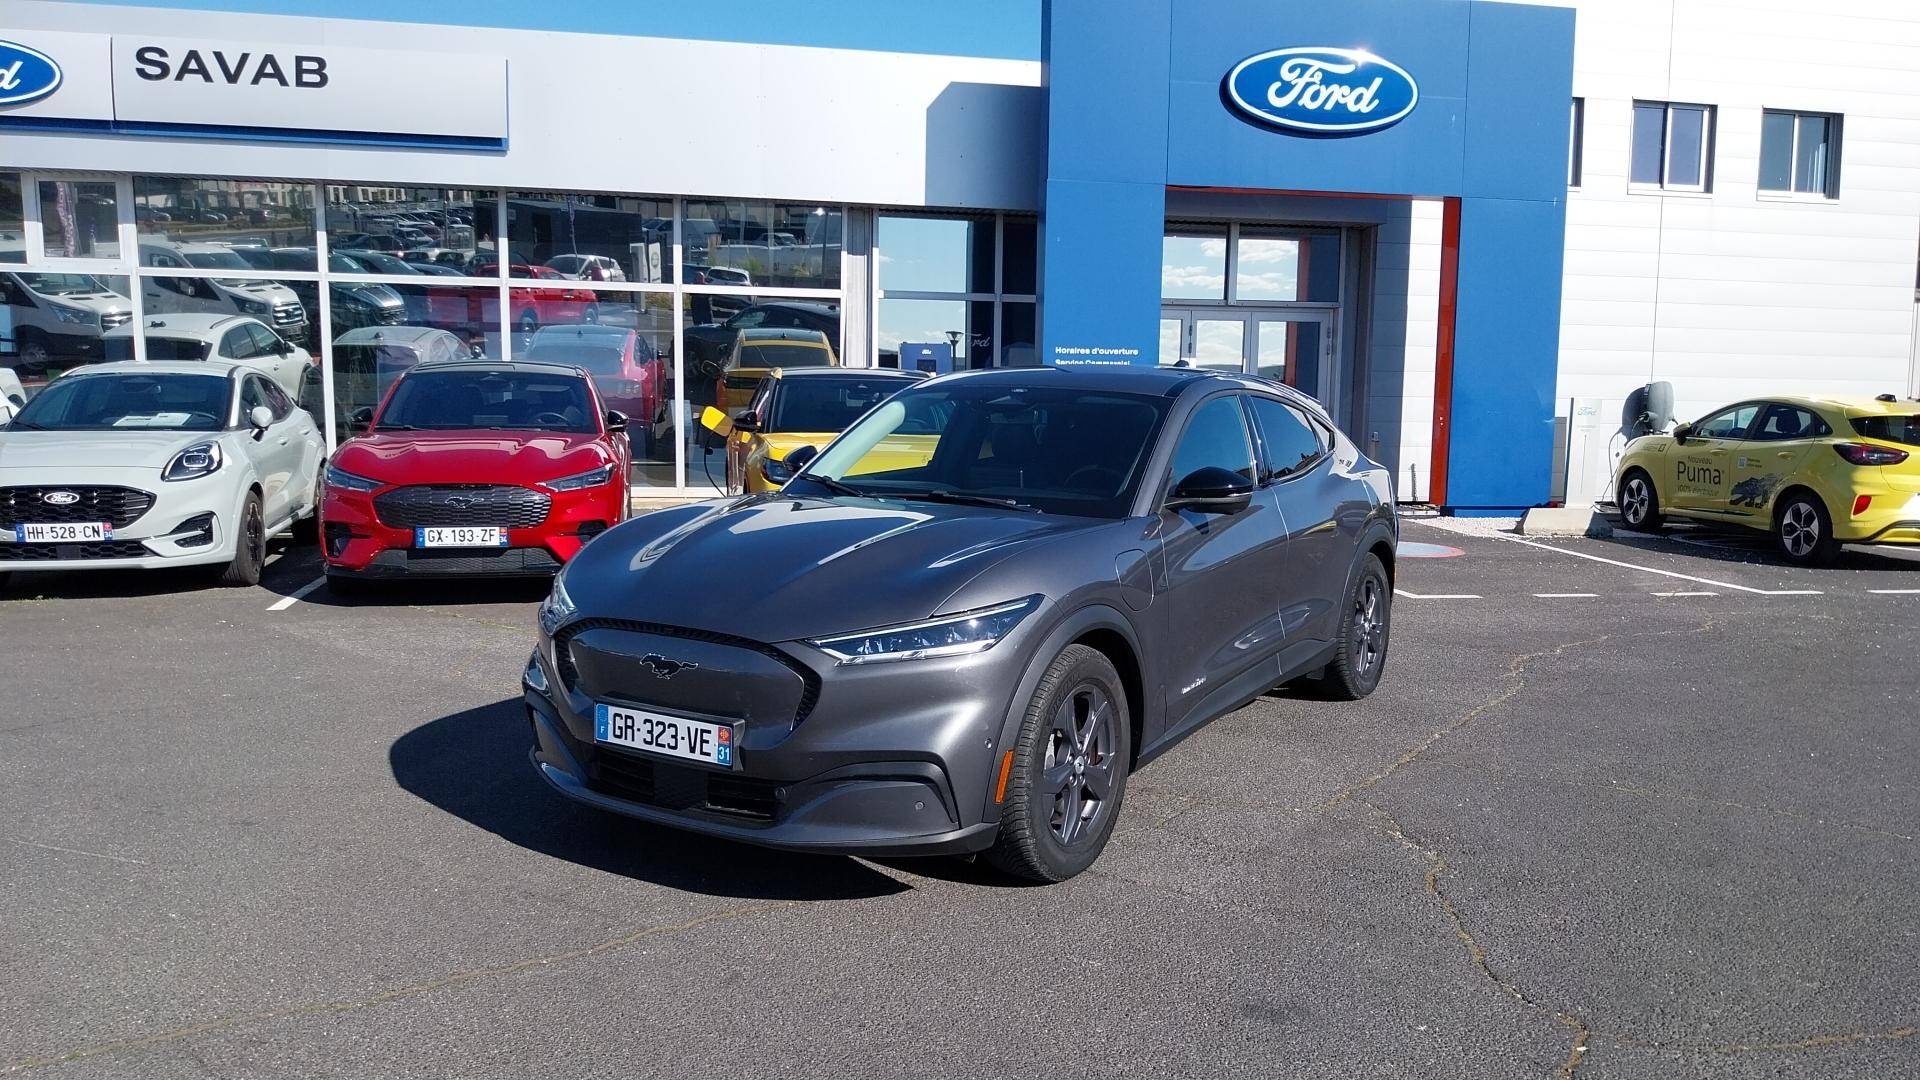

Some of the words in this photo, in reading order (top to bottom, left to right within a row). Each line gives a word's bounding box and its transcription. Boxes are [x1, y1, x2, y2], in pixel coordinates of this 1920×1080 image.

[135, 46, 329, 88] SAVAB
[1267, 57, 1384, 114] Ford
[1055, 346, 1090, 355] Horaires
[1091, 347, 1139, 356] d'ouverture
[1688, 455, 1713, 465] Nouveau
[1677, 460, 1721, 485] Puma
[26, 525, 101, 540] HH-528-CN
[427, 528, 496, 543] GX-193-ZF
[612, 712, 712, 757] GR-323-VE
[718, 746, 730, 761] 31
